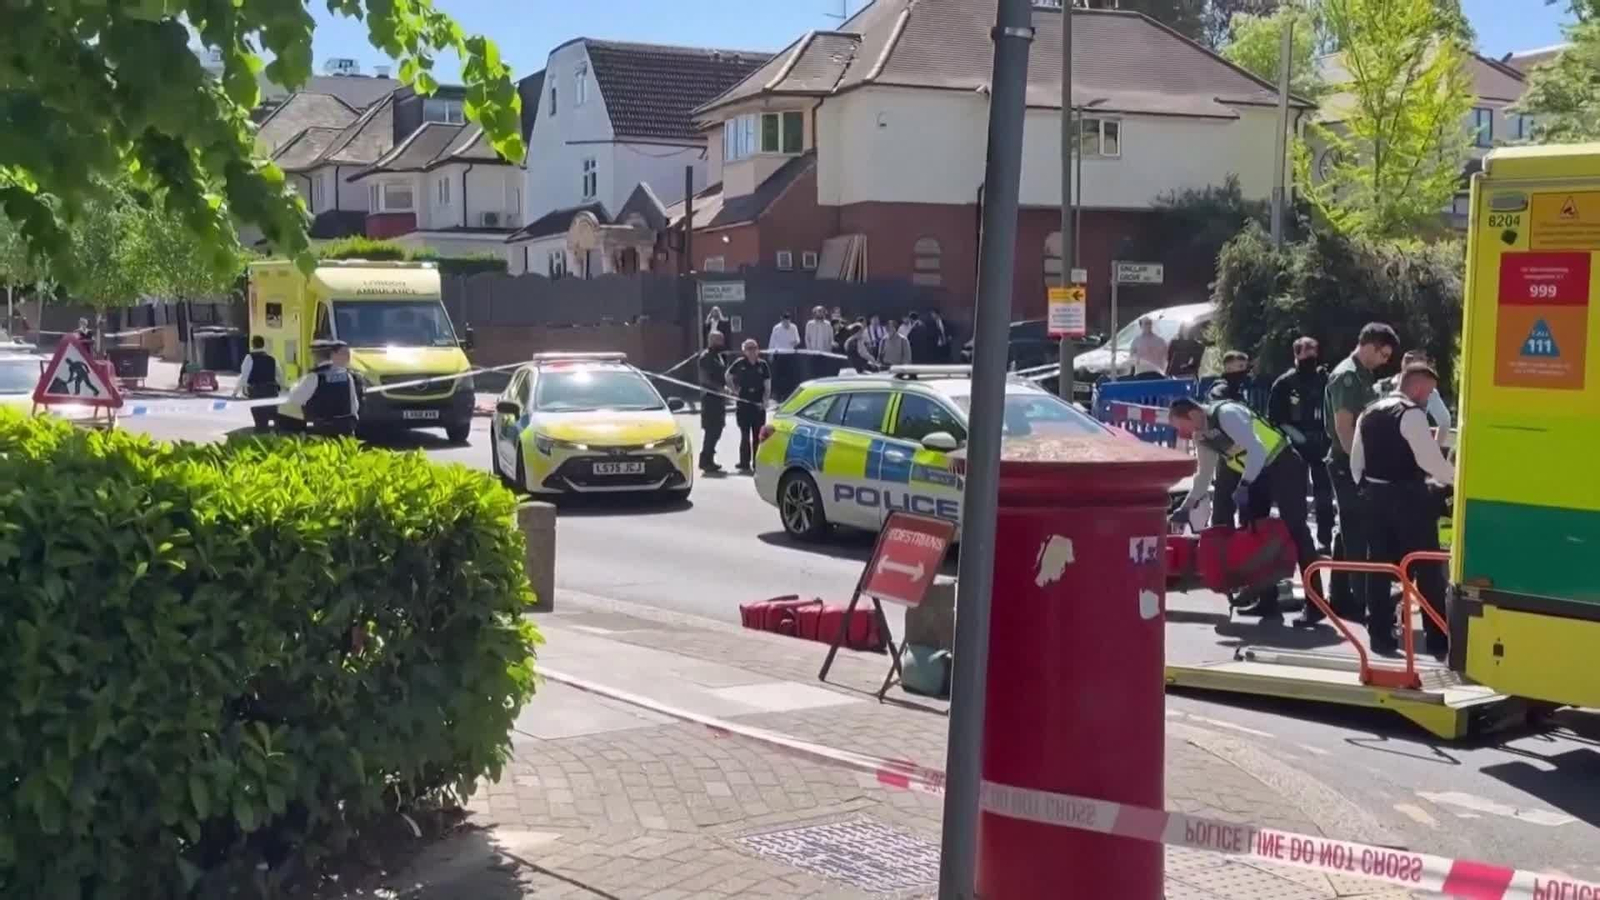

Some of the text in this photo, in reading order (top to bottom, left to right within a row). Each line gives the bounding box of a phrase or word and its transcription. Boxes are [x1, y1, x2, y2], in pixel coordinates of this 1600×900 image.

[1488, 214, 1520, 228] 8204
[1529, 284, 1557, 298] 999
[1527, 339, 1552, 354] 111
[834, 483, 959, 520] POLICE
